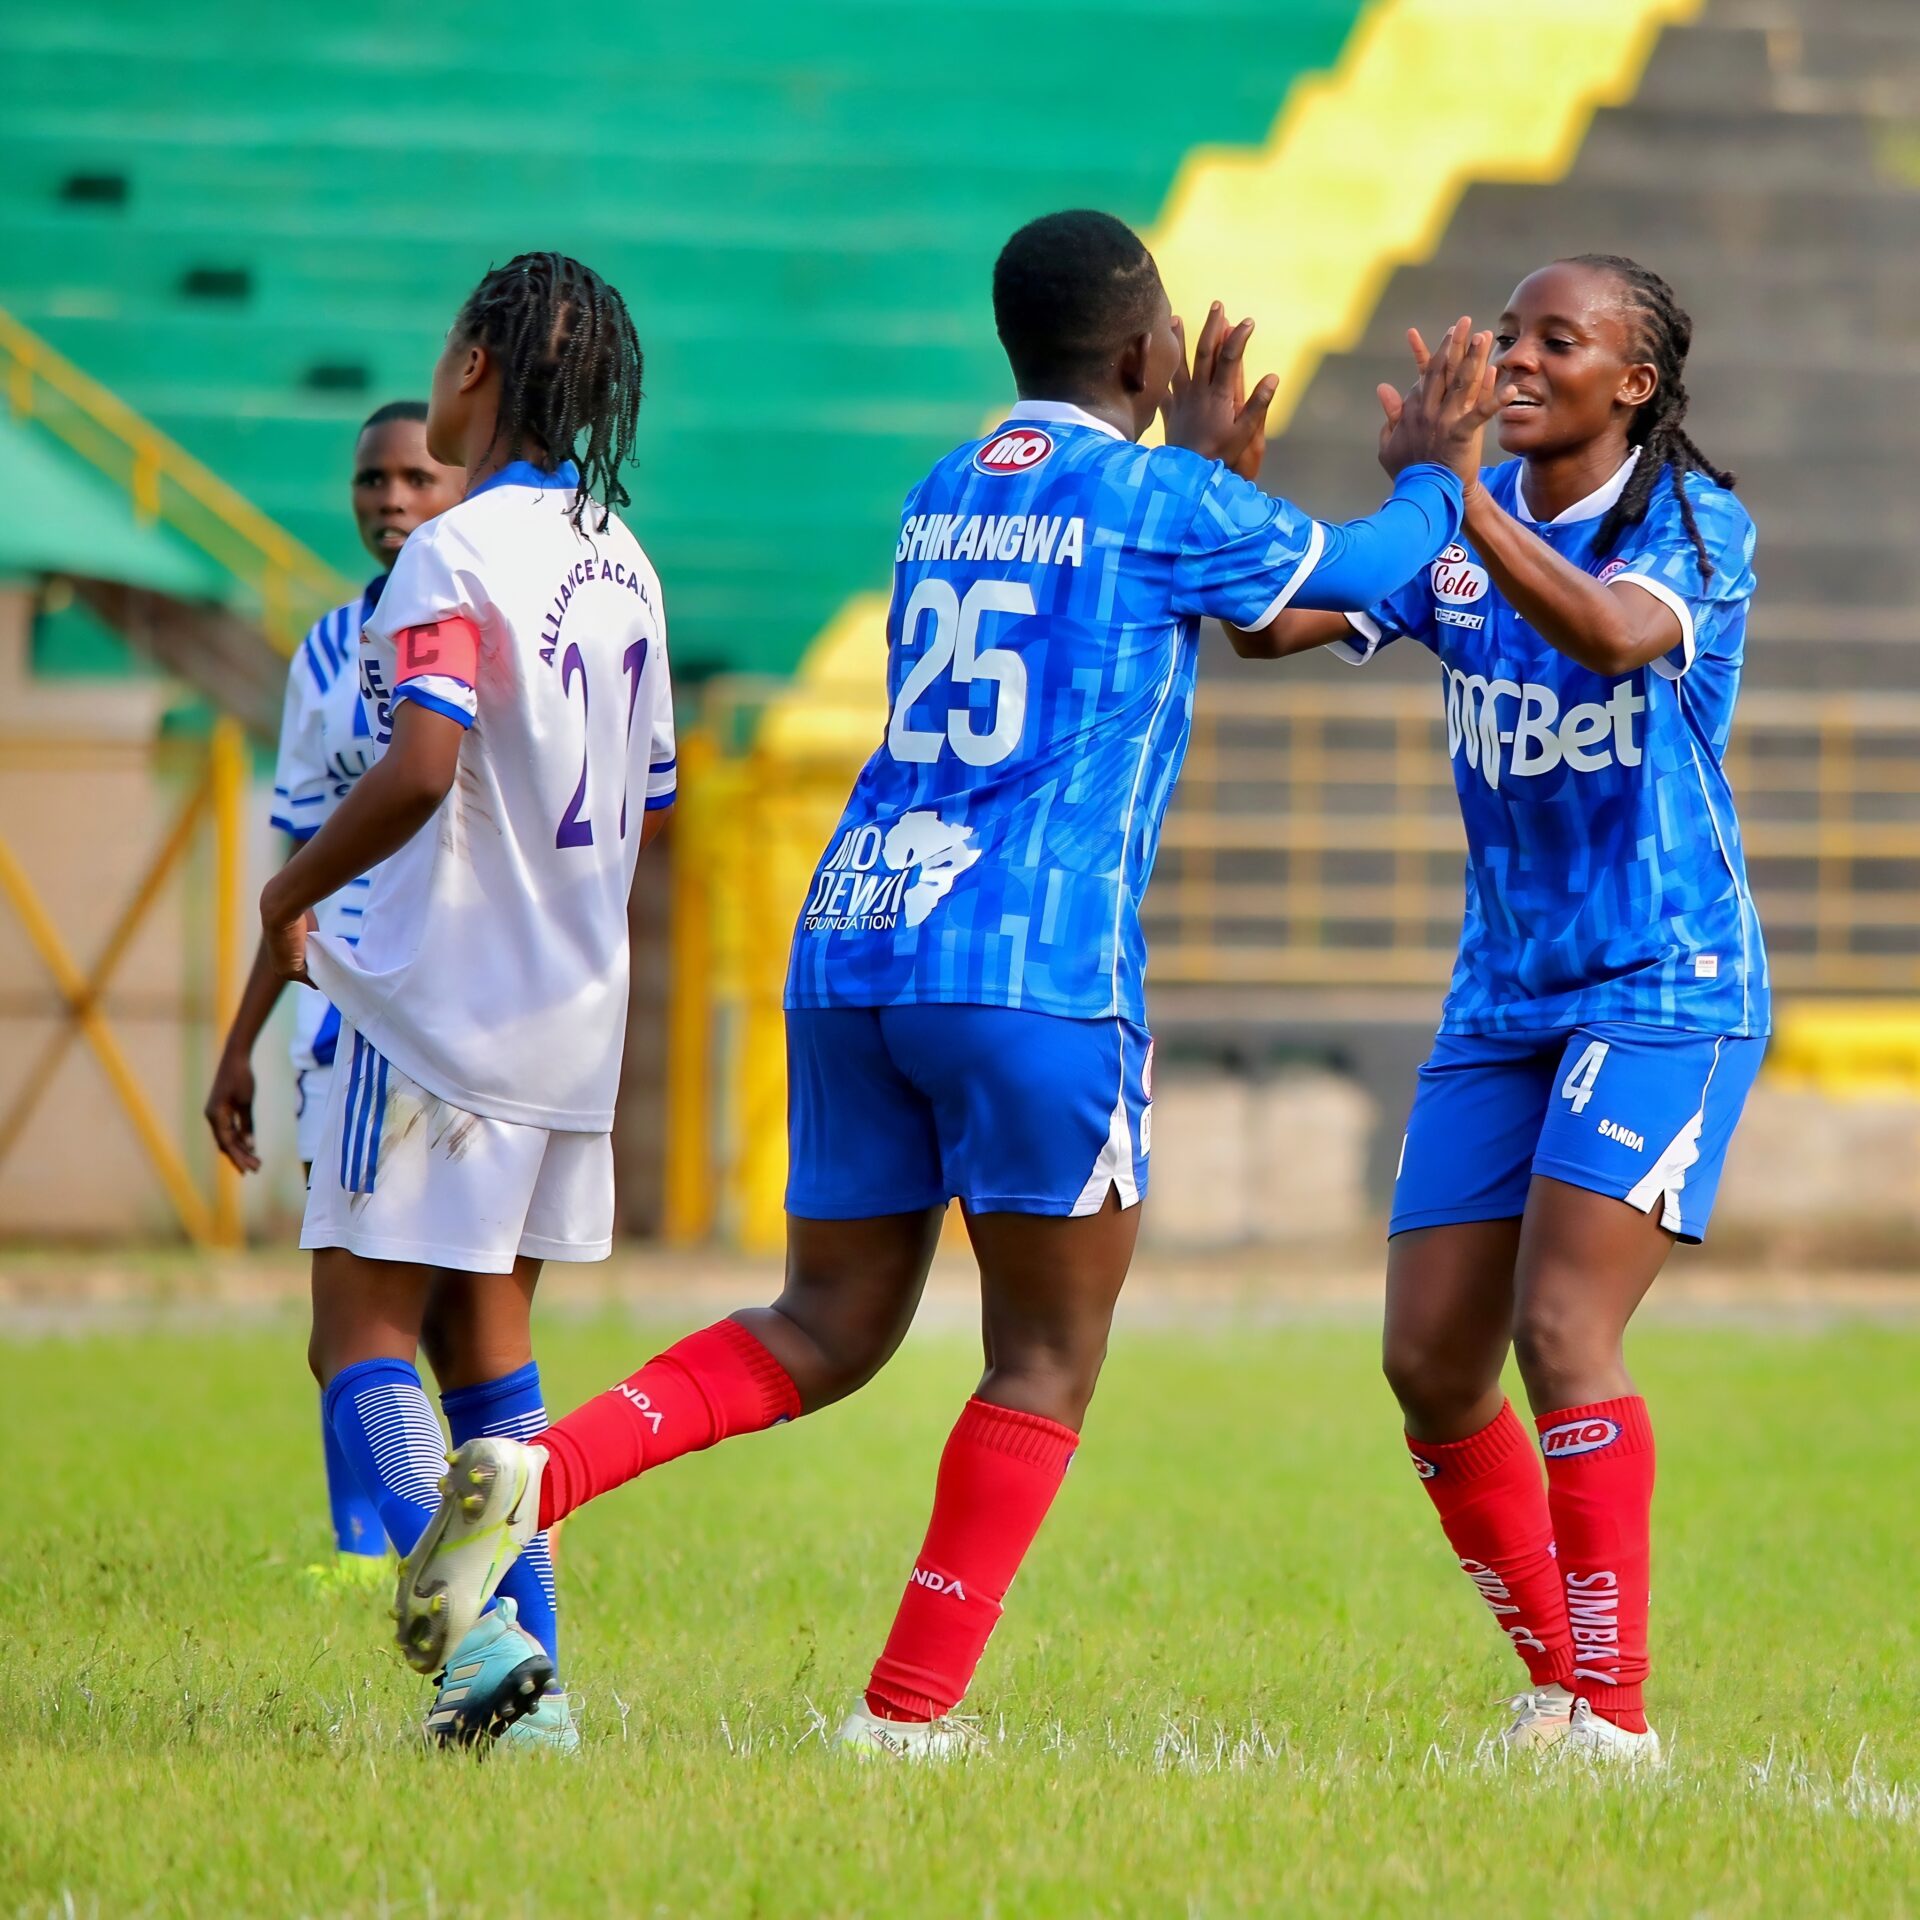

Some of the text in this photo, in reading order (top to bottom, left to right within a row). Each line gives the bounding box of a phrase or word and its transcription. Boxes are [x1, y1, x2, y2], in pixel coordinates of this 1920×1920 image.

[895, 513, 1085, 567] SHIKANGWA
[1434, 564, 1479, 598] Cola
[538, 558, 596, 669] ALLIANCE
[406, 624, 440, 670] C
[888, 577, 1037, 768] 25
[555, 637, 649, 850] 21
[806, 869, 910, 917] DEWJI
[803, 914, 898, 931] FOUNDATION
[1561, 1040, 1611, 1114] 4
[1597, 1118, 1645, 1153] SANDA
[609, 1382, 664, 1435] NDA
[910, 1566, 966, 1601] NDA
[1565, 1570, 1620, 1662] SIMBA
